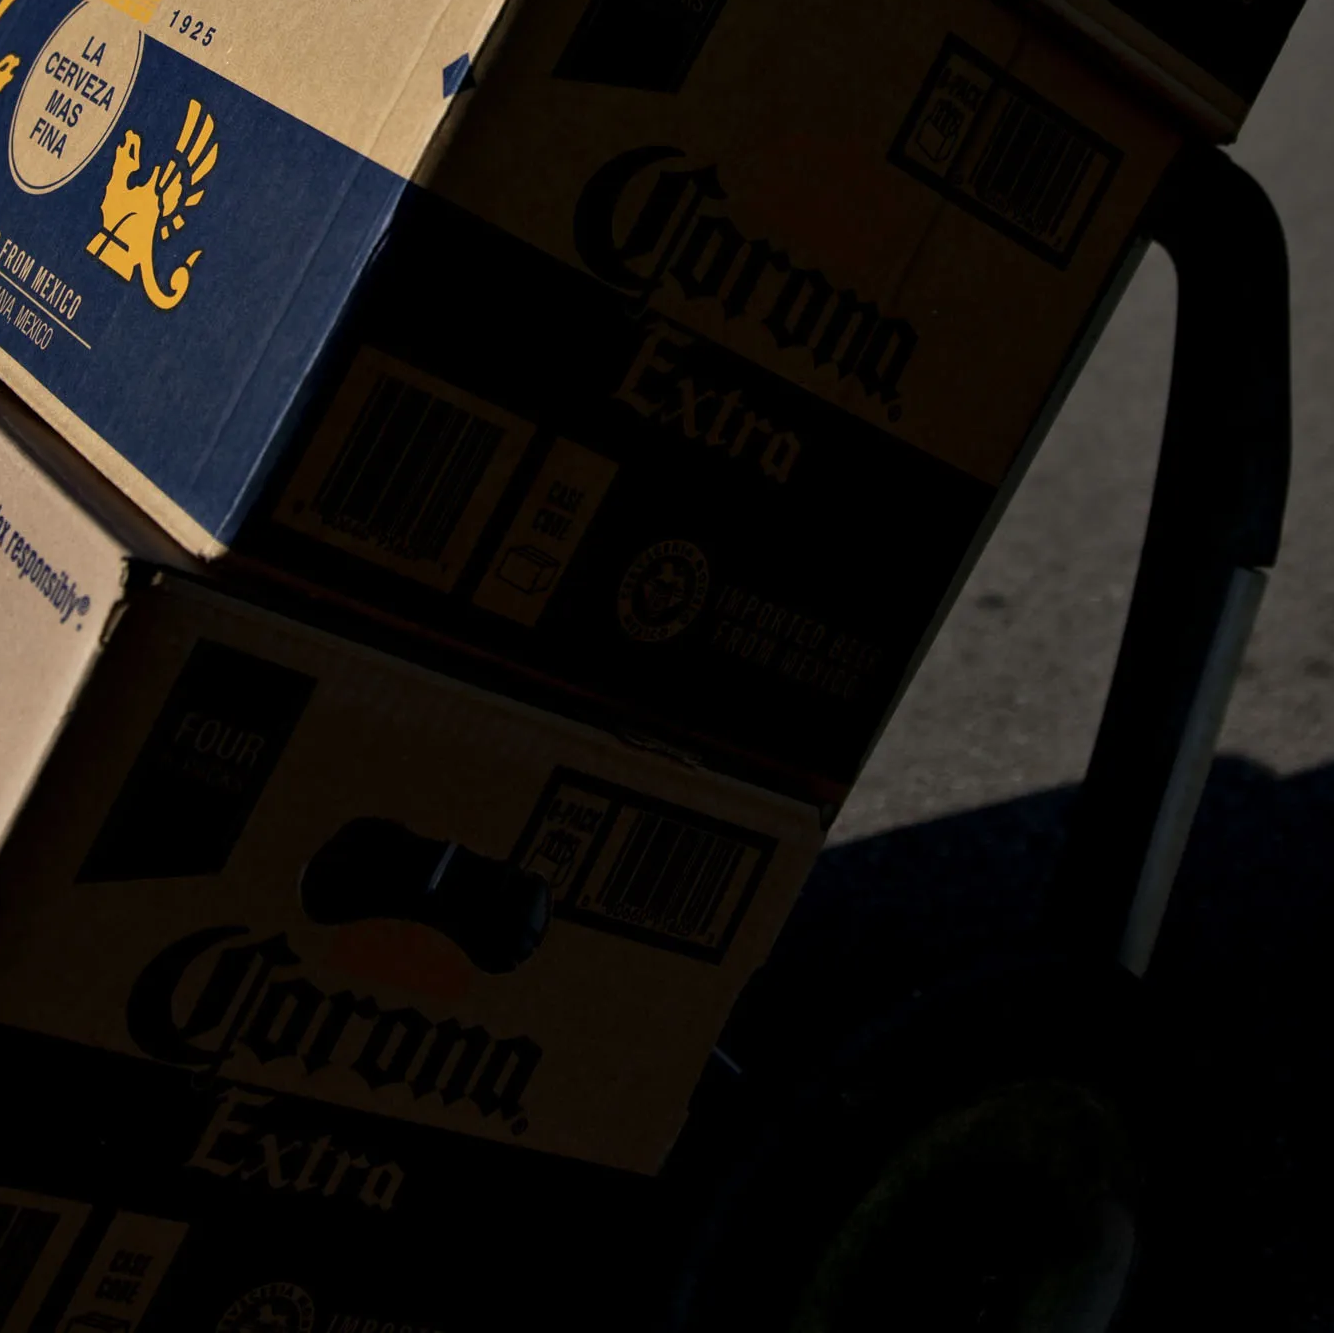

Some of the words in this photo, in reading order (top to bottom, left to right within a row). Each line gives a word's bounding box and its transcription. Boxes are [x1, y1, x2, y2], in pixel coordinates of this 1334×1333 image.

[81, 35, 107, 66] LA
[168, 8, 217, 47] 1925
[44, 51, 116, 112] CERVEZA
[45, 89, 83, 128] MAS
[29, 117, 68, 159] FINA
[30, 264, 83, 321] MEXICO
[13, 307, 55, 351] MEXICO
[609, 320, 803, 486] Extra
[715, 581, 828, 650] IMPORTED
[173, 711, 266, 769] FOUR
[182, 1086, 406, 1213] Extra
